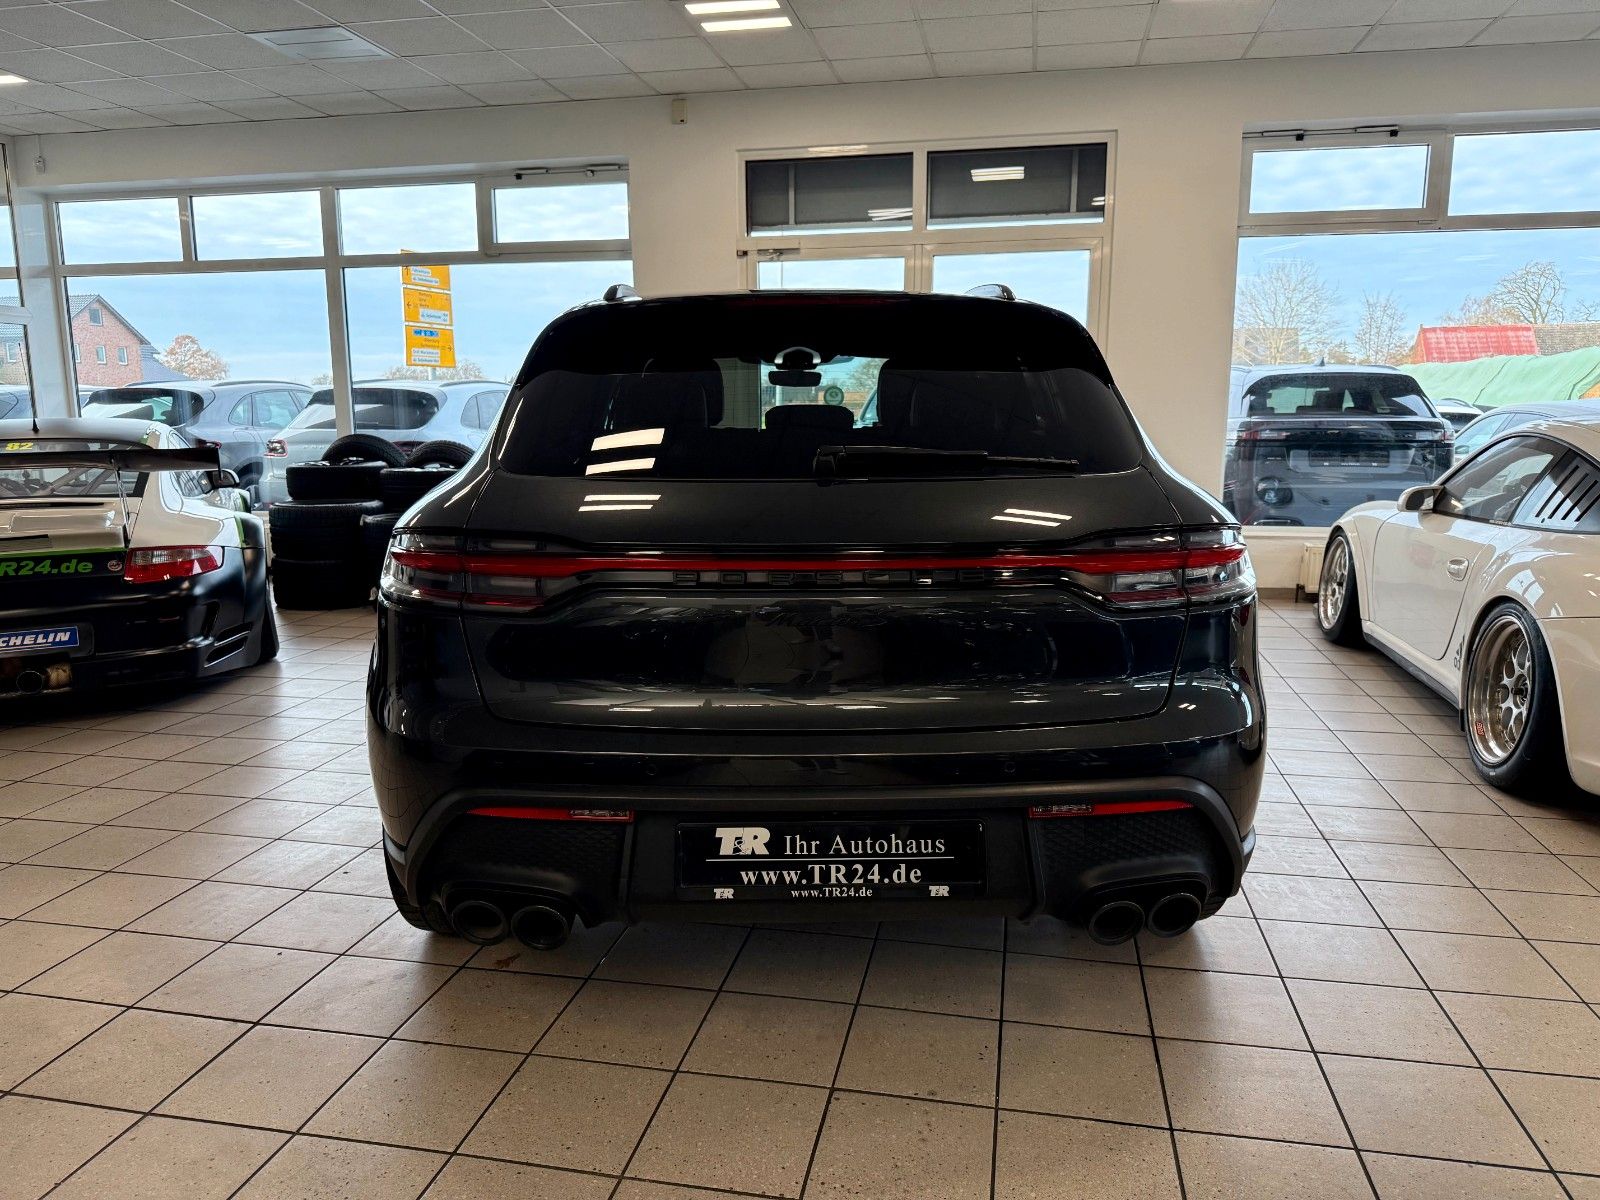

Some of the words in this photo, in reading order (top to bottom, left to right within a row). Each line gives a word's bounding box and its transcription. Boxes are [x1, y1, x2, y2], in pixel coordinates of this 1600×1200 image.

[5, 442, 34, 451] 82
[785, 835, 820, 855] Ihr
[829, 834, 946, 855] Autohaus
[740, 864, 922, 885] www.TR24.de
[791, 887, 873, 898] www.TR24.de
